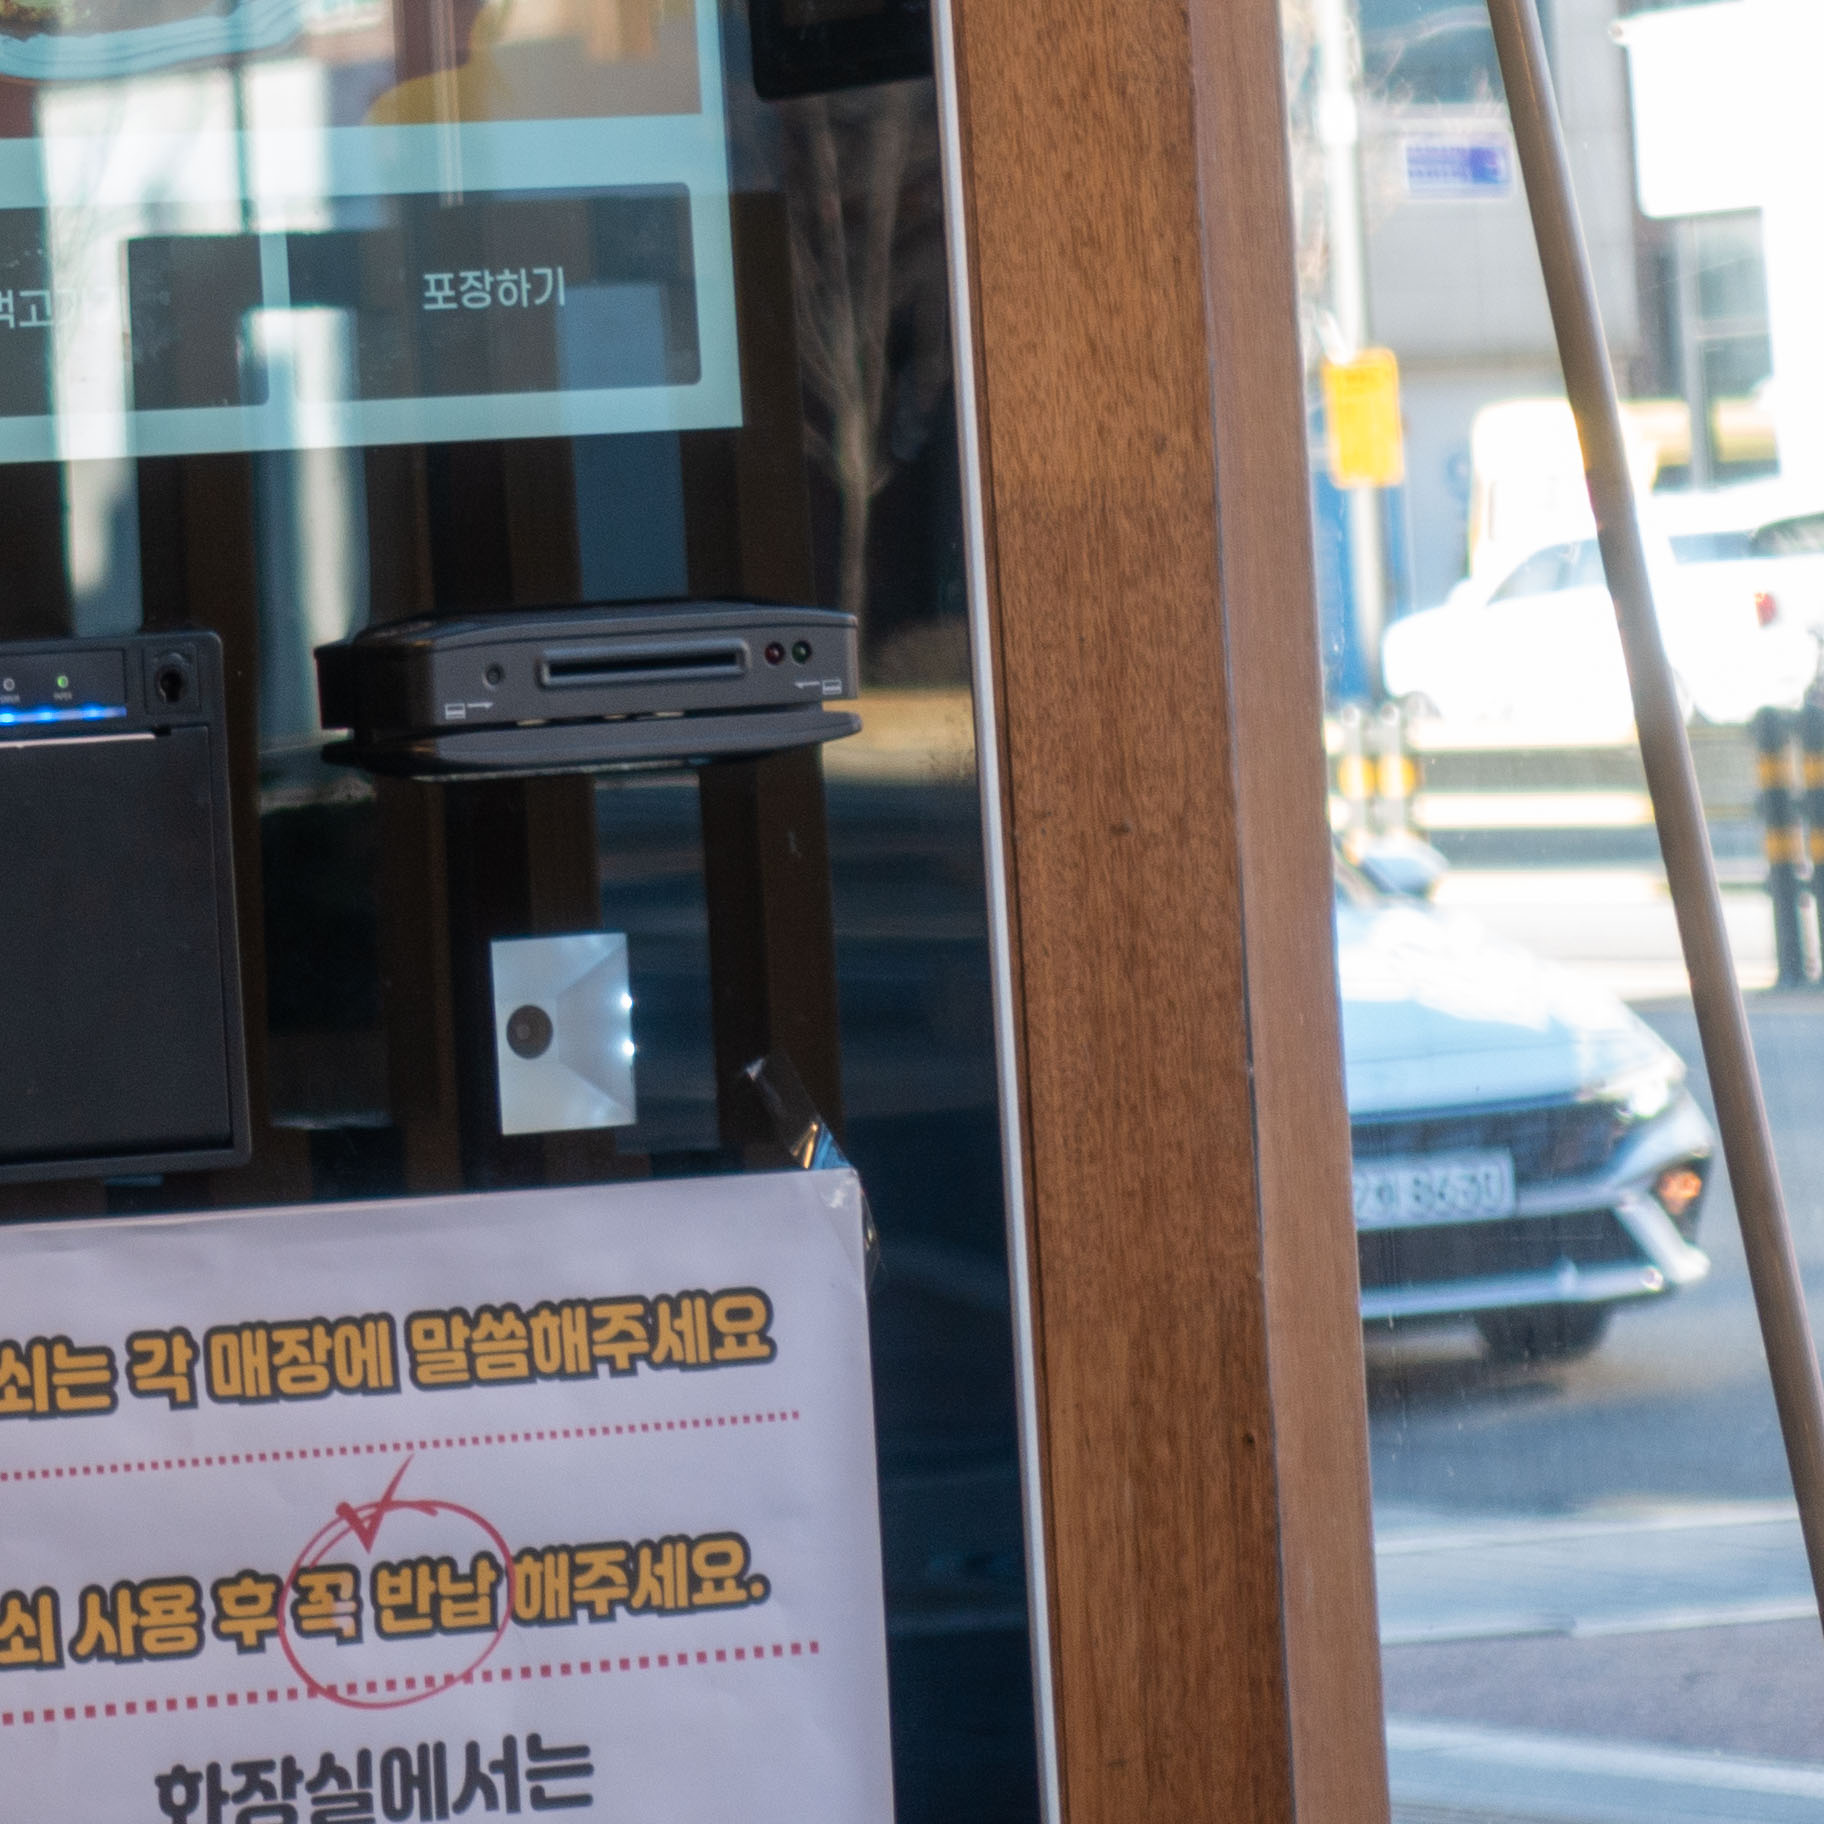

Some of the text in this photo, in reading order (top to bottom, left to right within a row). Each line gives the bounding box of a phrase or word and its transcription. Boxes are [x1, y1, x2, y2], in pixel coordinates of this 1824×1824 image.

[422, 266, 566, 312] 포장하기
[127, 1327, 198, 1410] 각
[206, 1311, 397, 1405] 매장에
[405, 1288, 777, 1387] 말씀해주세요
[70, 1577, 203, 1669] 사용
[211, 1572, 287, 1653] 후
[294, 1565, 362, 1645] 꼭
[370, 1554, 505, 1644] 반납
[509, 1531, 770, 1627] 해주세요.
[155, 1732, 595, 1824] 화장실에서는
